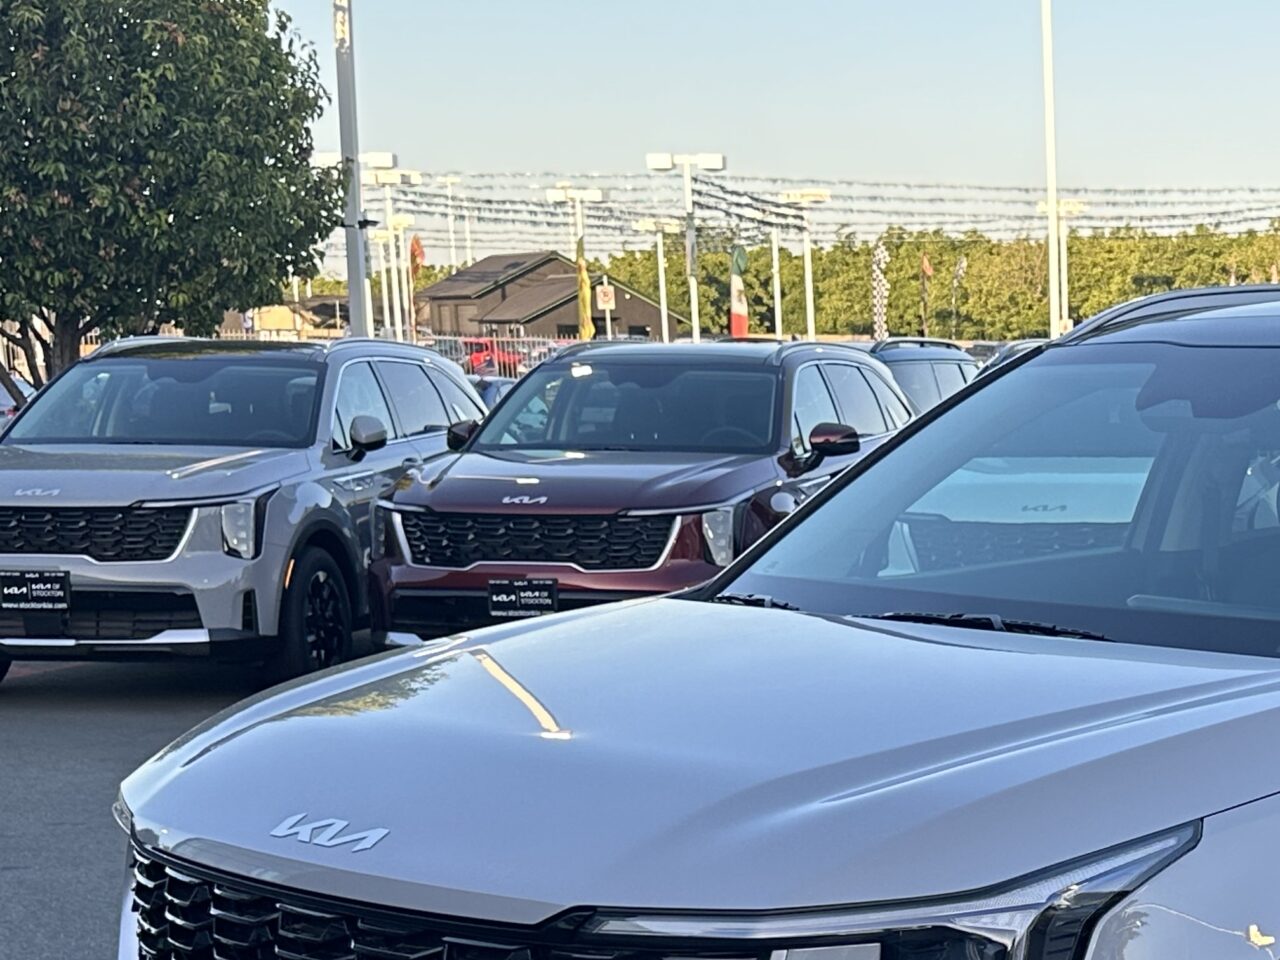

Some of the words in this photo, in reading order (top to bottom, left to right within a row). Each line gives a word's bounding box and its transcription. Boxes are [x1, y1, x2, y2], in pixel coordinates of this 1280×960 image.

[15, 488, 60, 496] KIA
[502, 496, 548, 504] KIA
[3, 586, 27, 594] KIA
[270, 812, 391, 853] KIA
